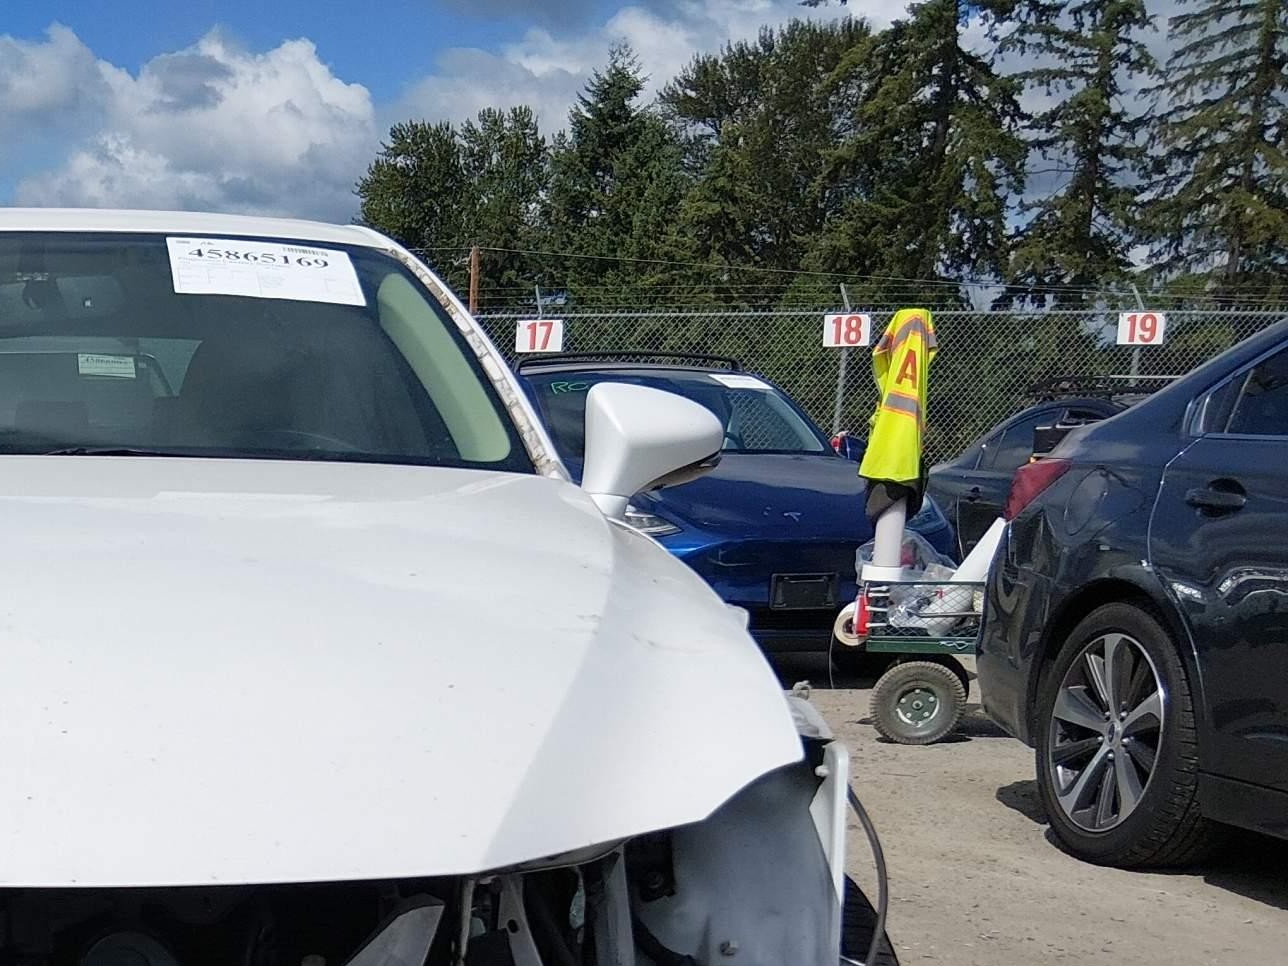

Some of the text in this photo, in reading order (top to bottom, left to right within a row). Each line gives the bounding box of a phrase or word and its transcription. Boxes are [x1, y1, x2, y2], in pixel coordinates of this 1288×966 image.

[188, 248, 329, 268] 45865169
[527, 321, 553, 350] 17
[832, 315, 862, 345] 18
[1127, 313, 1158, 343] 19
[896, 349, 917, 389] A
